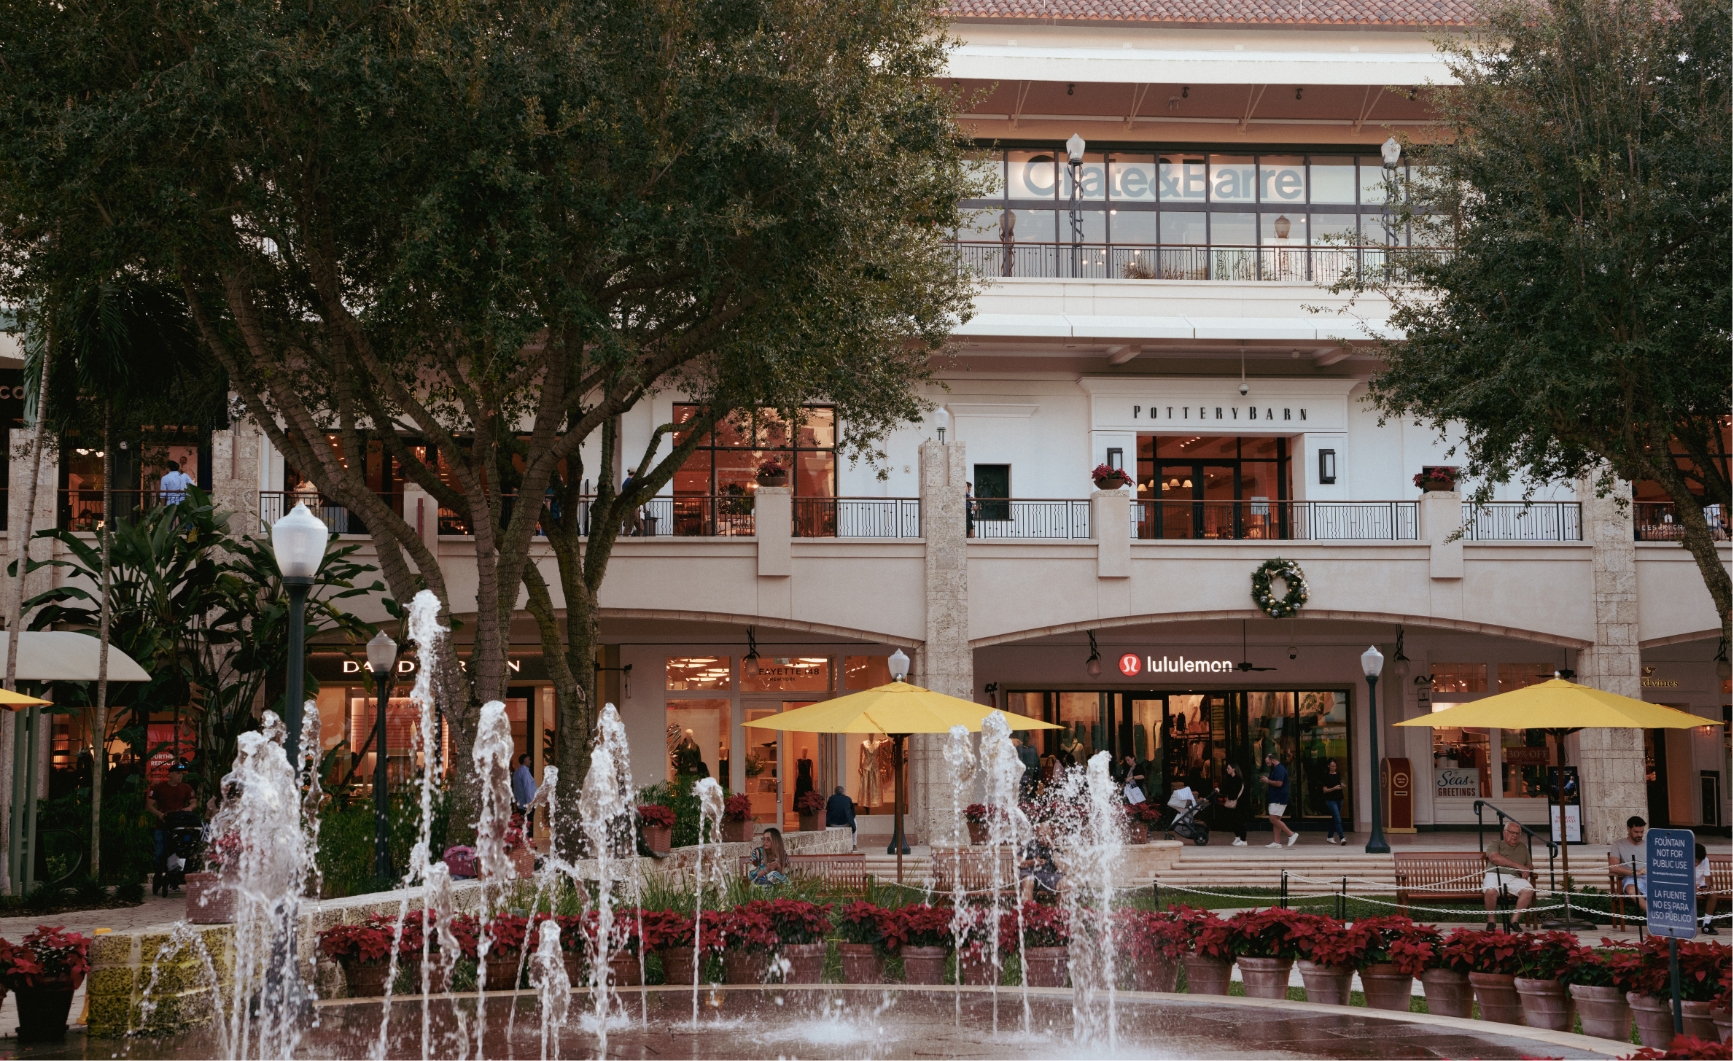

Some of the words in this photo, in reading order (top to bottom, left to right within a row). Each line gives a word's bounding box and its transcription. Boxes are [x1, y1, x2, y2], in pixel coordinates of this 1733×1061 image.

[343, 660, 415, 673] DAD
[1147, 656, 1233, 673] lululemon
[758, 668, 802, 676] FAYETTE
[1651, 678, 1679, 688] vines
[1508, 750, 1528, 759] 30%
[1529, 750, 1549, 758] OFF
[1437, 770, 1469, 787] Seas
[1437, 787, 1476, 797] GREETINGS
[1654, 837, 1686, 847] FOUNTAIN
[1656, 849, 1670, 857] NOT
[1670, 850, 1684, 858] FOR
[1652, 859, 1674, 869] PUBLIC
[1675, 861, 1688, 870] USE
[1654, 890, 1663, 898] LA
[1663, 890, 1687, 901] FUENTE
[1652, 900, 1663, 909] NO
[1663, 901, 1672, 910] ES
[1672, 902, 1690, 911] PARA
[1650, 911, 1665, 920] USO
[1665, 911, 1692, 923] PÚBLICO
